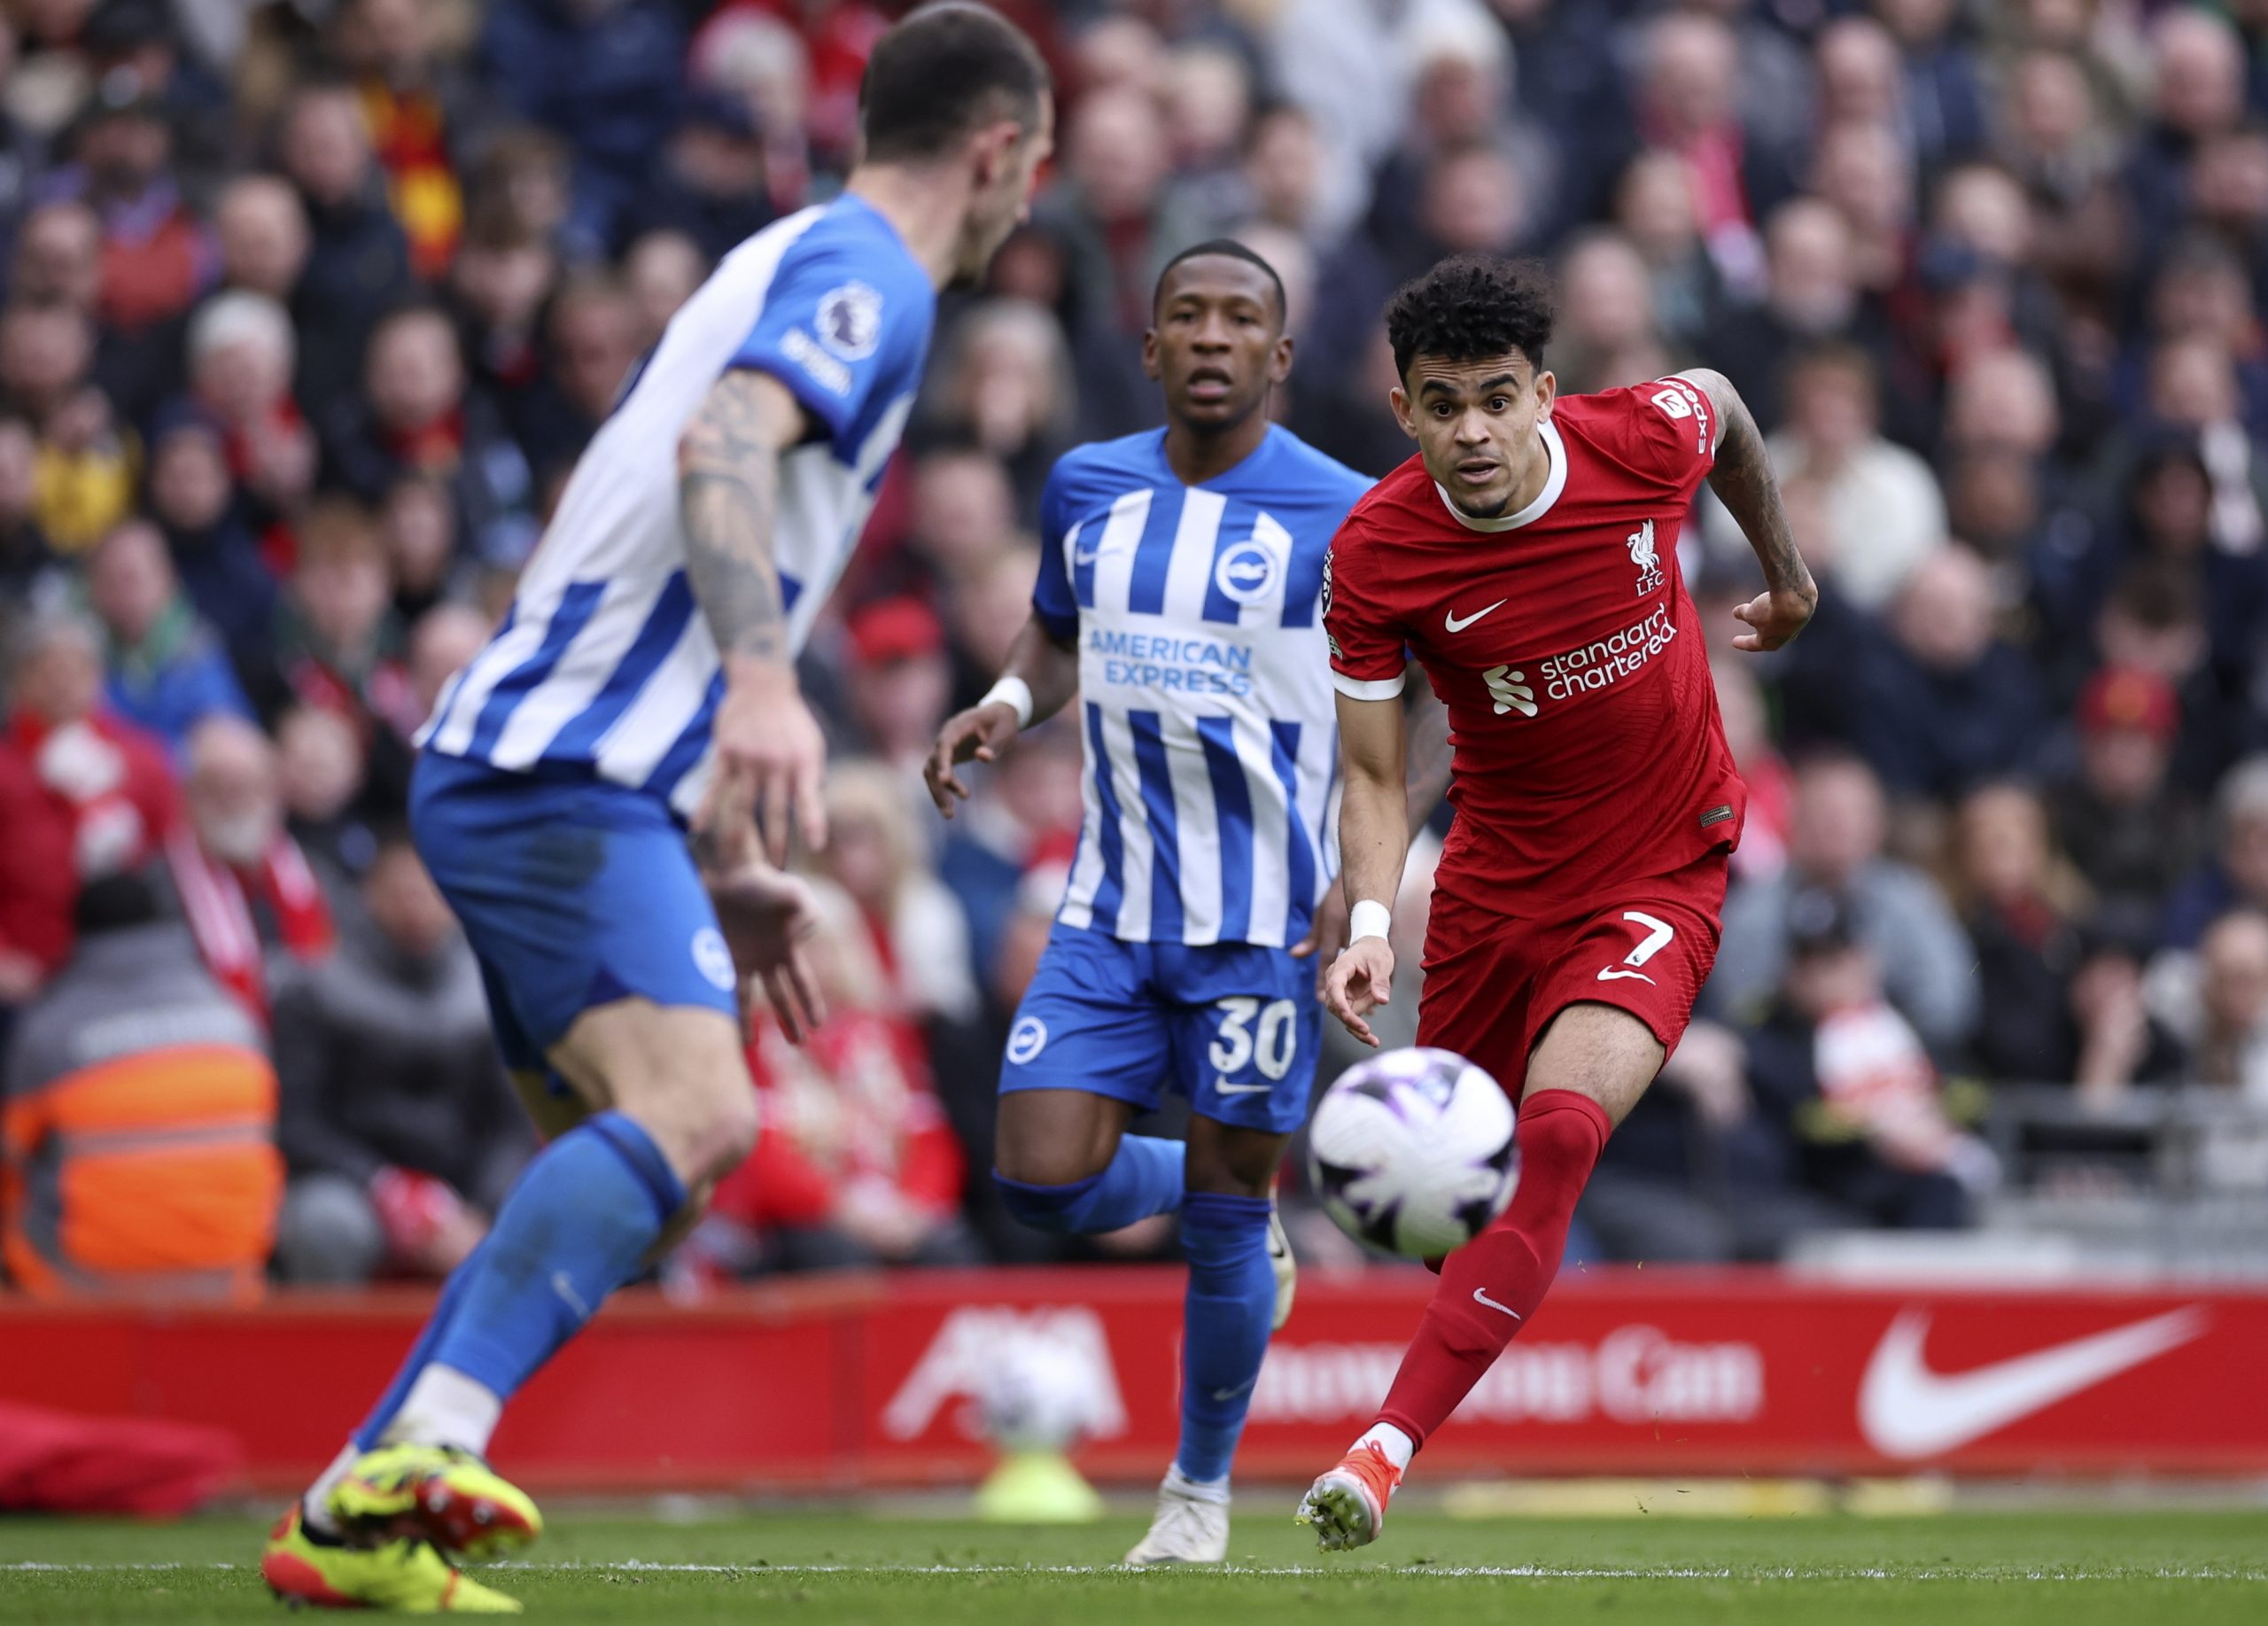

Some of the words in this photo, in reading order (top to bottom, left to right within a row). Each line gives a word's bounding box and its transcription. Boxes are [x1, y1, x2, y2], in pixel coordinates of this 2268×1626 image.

[1657, 380, 1708, 455] Exped
[1091, 629, 1253, 669] AMERICAN
[1106, 661, 1252, 697] EXPRESS
[1540, 603, 1666, 681] standard
[1547, 616, 1678, 700] chartered
[1623, 911, 1674, 968] 7
[1208, 995, 1297, 1081] 30
